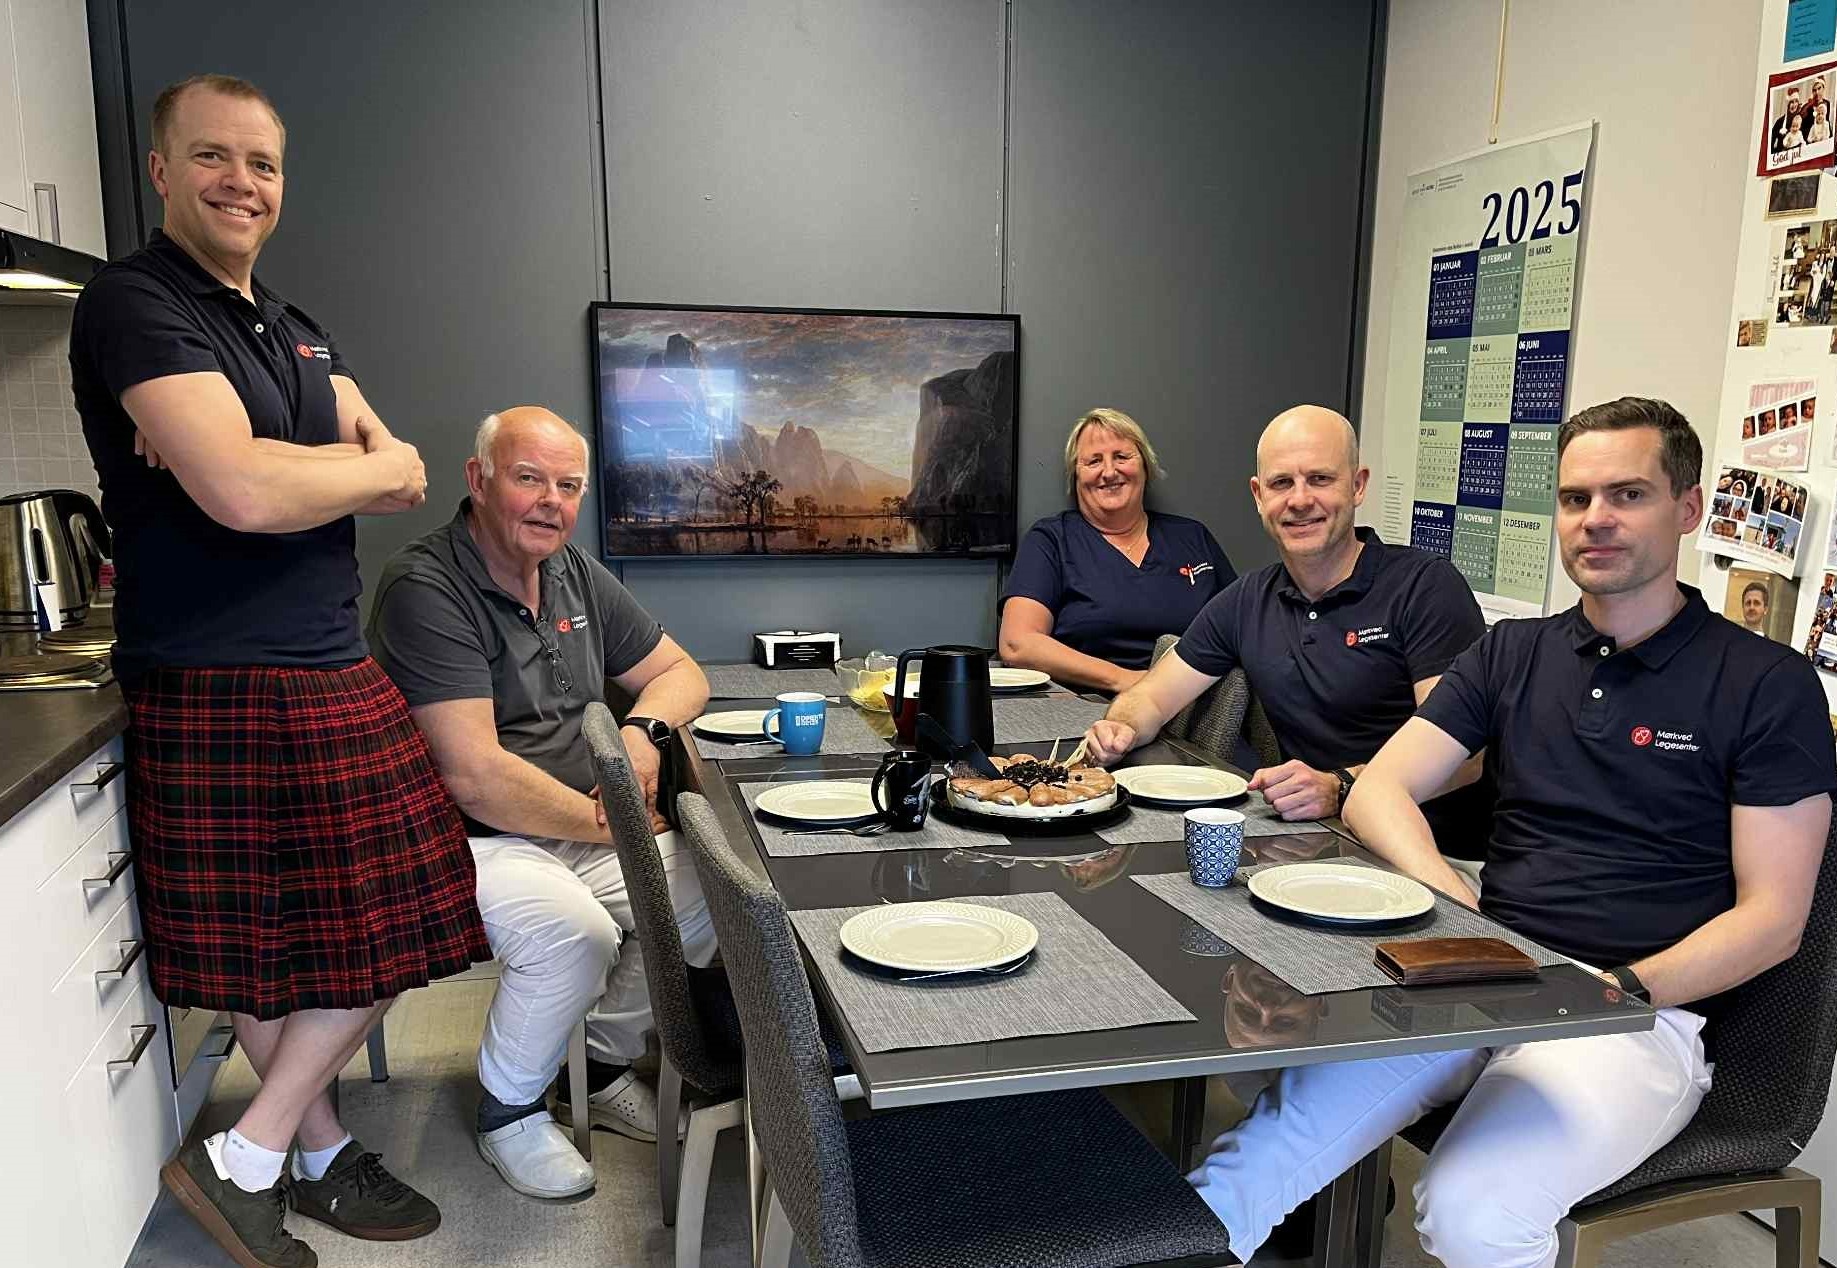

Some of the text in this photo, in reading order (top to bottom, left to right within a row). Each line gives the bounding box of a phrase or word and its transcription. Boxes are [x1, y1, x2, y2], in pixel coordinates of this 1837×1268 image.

[1772, 149, 1802, 167] God jul
[1479, 169, 1584, 250] 2025
[1536, 245, 1552, 255] MARS
[1487, 251, 1512, 264] FEBRUAR
[1440, 260, 1461, 272] JANUAR
[1434, 345, 1448, 354] APRIL
[1480, 344, 1490, 352] MAI
[1518, 339, 1540, 351] 06 JUNI
[1428, 428, 1437, 437] JULI
[1464, 429, 1493, 438] 08 AUGUST
[1510, 430, 1552, 441] 09 SEPTEMBER
[1414, 507, 1444, 518] 10 OKTOBER
[1457, 511, 1493, 524] 11 NOVEMBER
[1503, 518, 1541, 531] 12 DESEMBER
[1656, 730, 1693, 741] Mørkved
[1655, 739, 1700, 751] Legesenter
